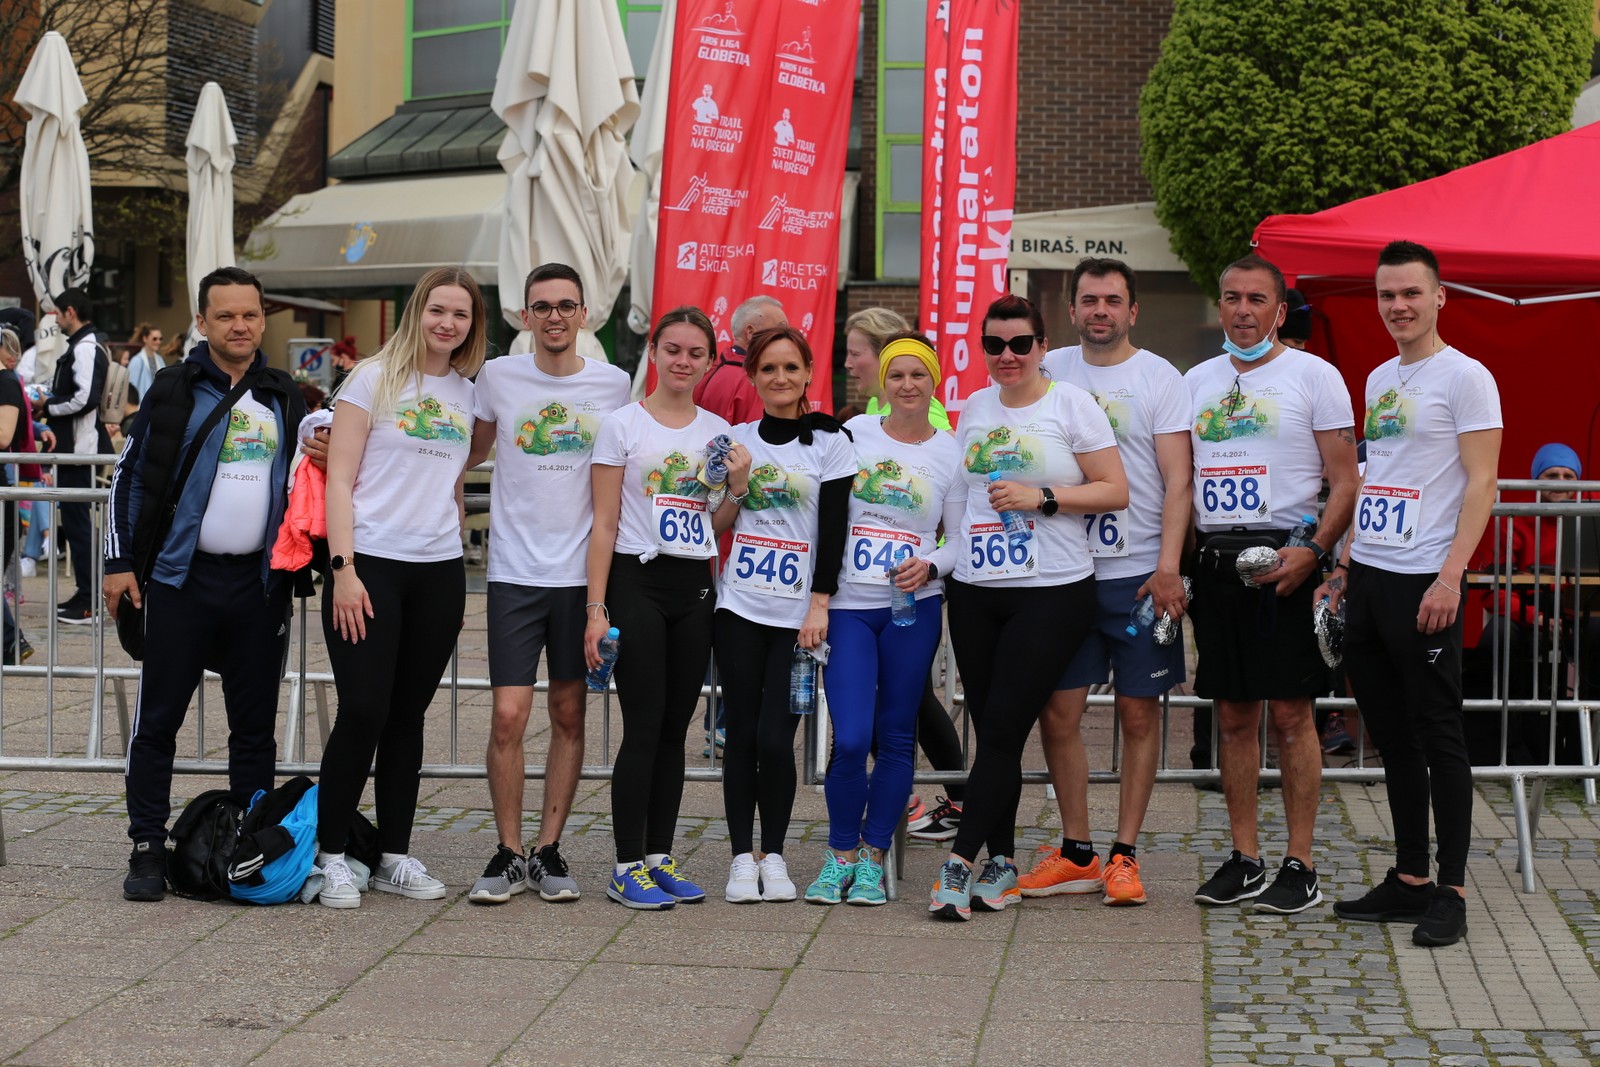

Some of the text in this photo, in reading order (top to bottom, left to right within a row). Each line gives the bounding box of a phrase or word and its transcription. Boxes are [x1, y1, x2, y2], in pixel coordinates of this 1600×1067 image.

[720, 39, 740, 49] LIGA
[777, 72, 826, 94] GLOBETKA
[720, 115, 743, 129] TRAIL
[690, 138, 704, 149] NA
[796, 139, 816, 154] TRAIL
[772, 146, 793, 158] SVETI
[771, 159, 784, 171] NA
[701, 205, 729, 216] KROS
[945, 27, 984, 412] Polumaraton
[781, 224, 803, 235] KROS
[1022, 235, 1079, 254] BIRAŠ.
[1085, 240, 1128, 255] PAN.
[779, 273, 818, 290] ŠKOLA
[418, 447, 453, 461] 25.4.2021.
[1211, 450, 1250, 458] 25.4.2021.
[537, 464, 576, 472] 25.4.2021.
[221, 472, 262, 482] 25.4.2021.
[1203, 477, 1261, 513] 638
[1359, 497, 1407, 535] 631
[660, 508, 705, 545] 639
[854, 528, 895, 539] Polumaraton
[737, 535, 778, 547] Polumaraton
[971, 534, 1028, 569] 566
[735, 546, 799, 586] 546
